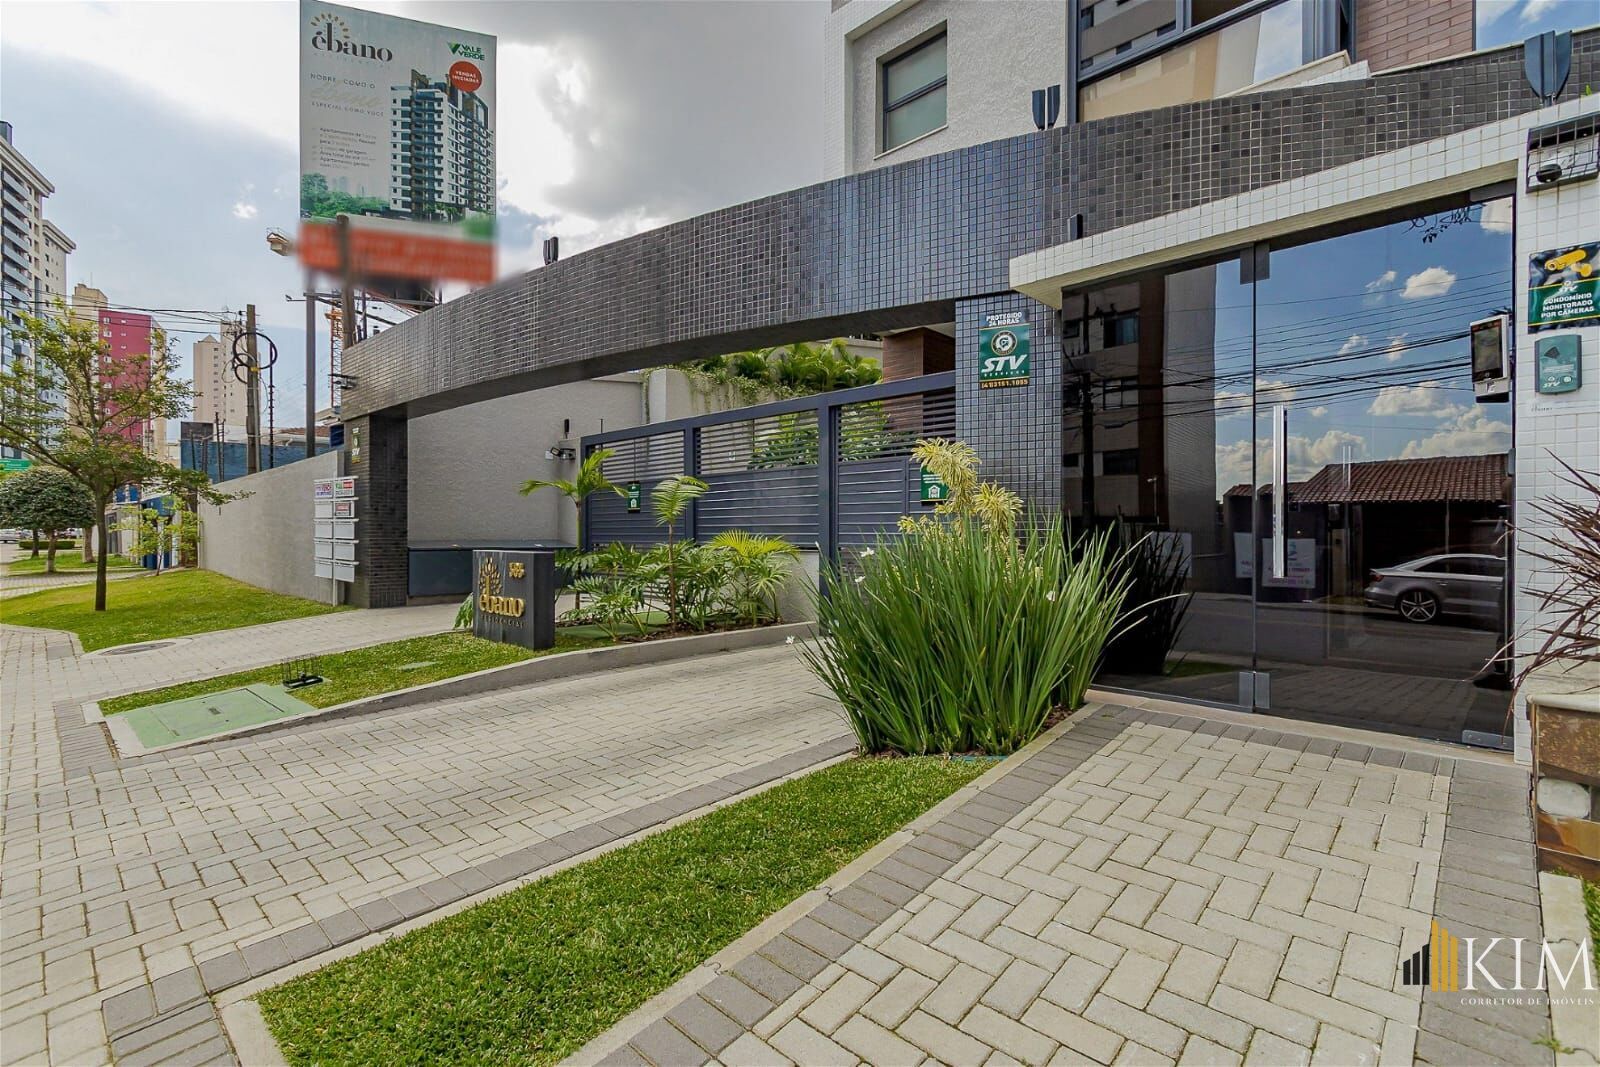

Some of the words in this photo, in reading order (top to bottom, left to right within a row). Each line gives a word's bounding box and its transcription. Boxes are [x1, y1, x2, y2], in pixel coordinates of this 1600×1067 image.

[461, 44, 482, 54] VALE
[458, 51, 485, 61] VERDE
[310, 73, 336, 82] NOBRE
[343, 79, 367, 88] COMO
[1543, 292, 1592, 305] CONDOMÍNIO
[1542, 300, 1593, 312] MONITORADO
[986, 311, 1023, 322] PROTEGIDO
[1541, 311, 1557, 319] POR
[997, 318, 1020, 326] HORAS
[981, 354, 1028, 373] STV
